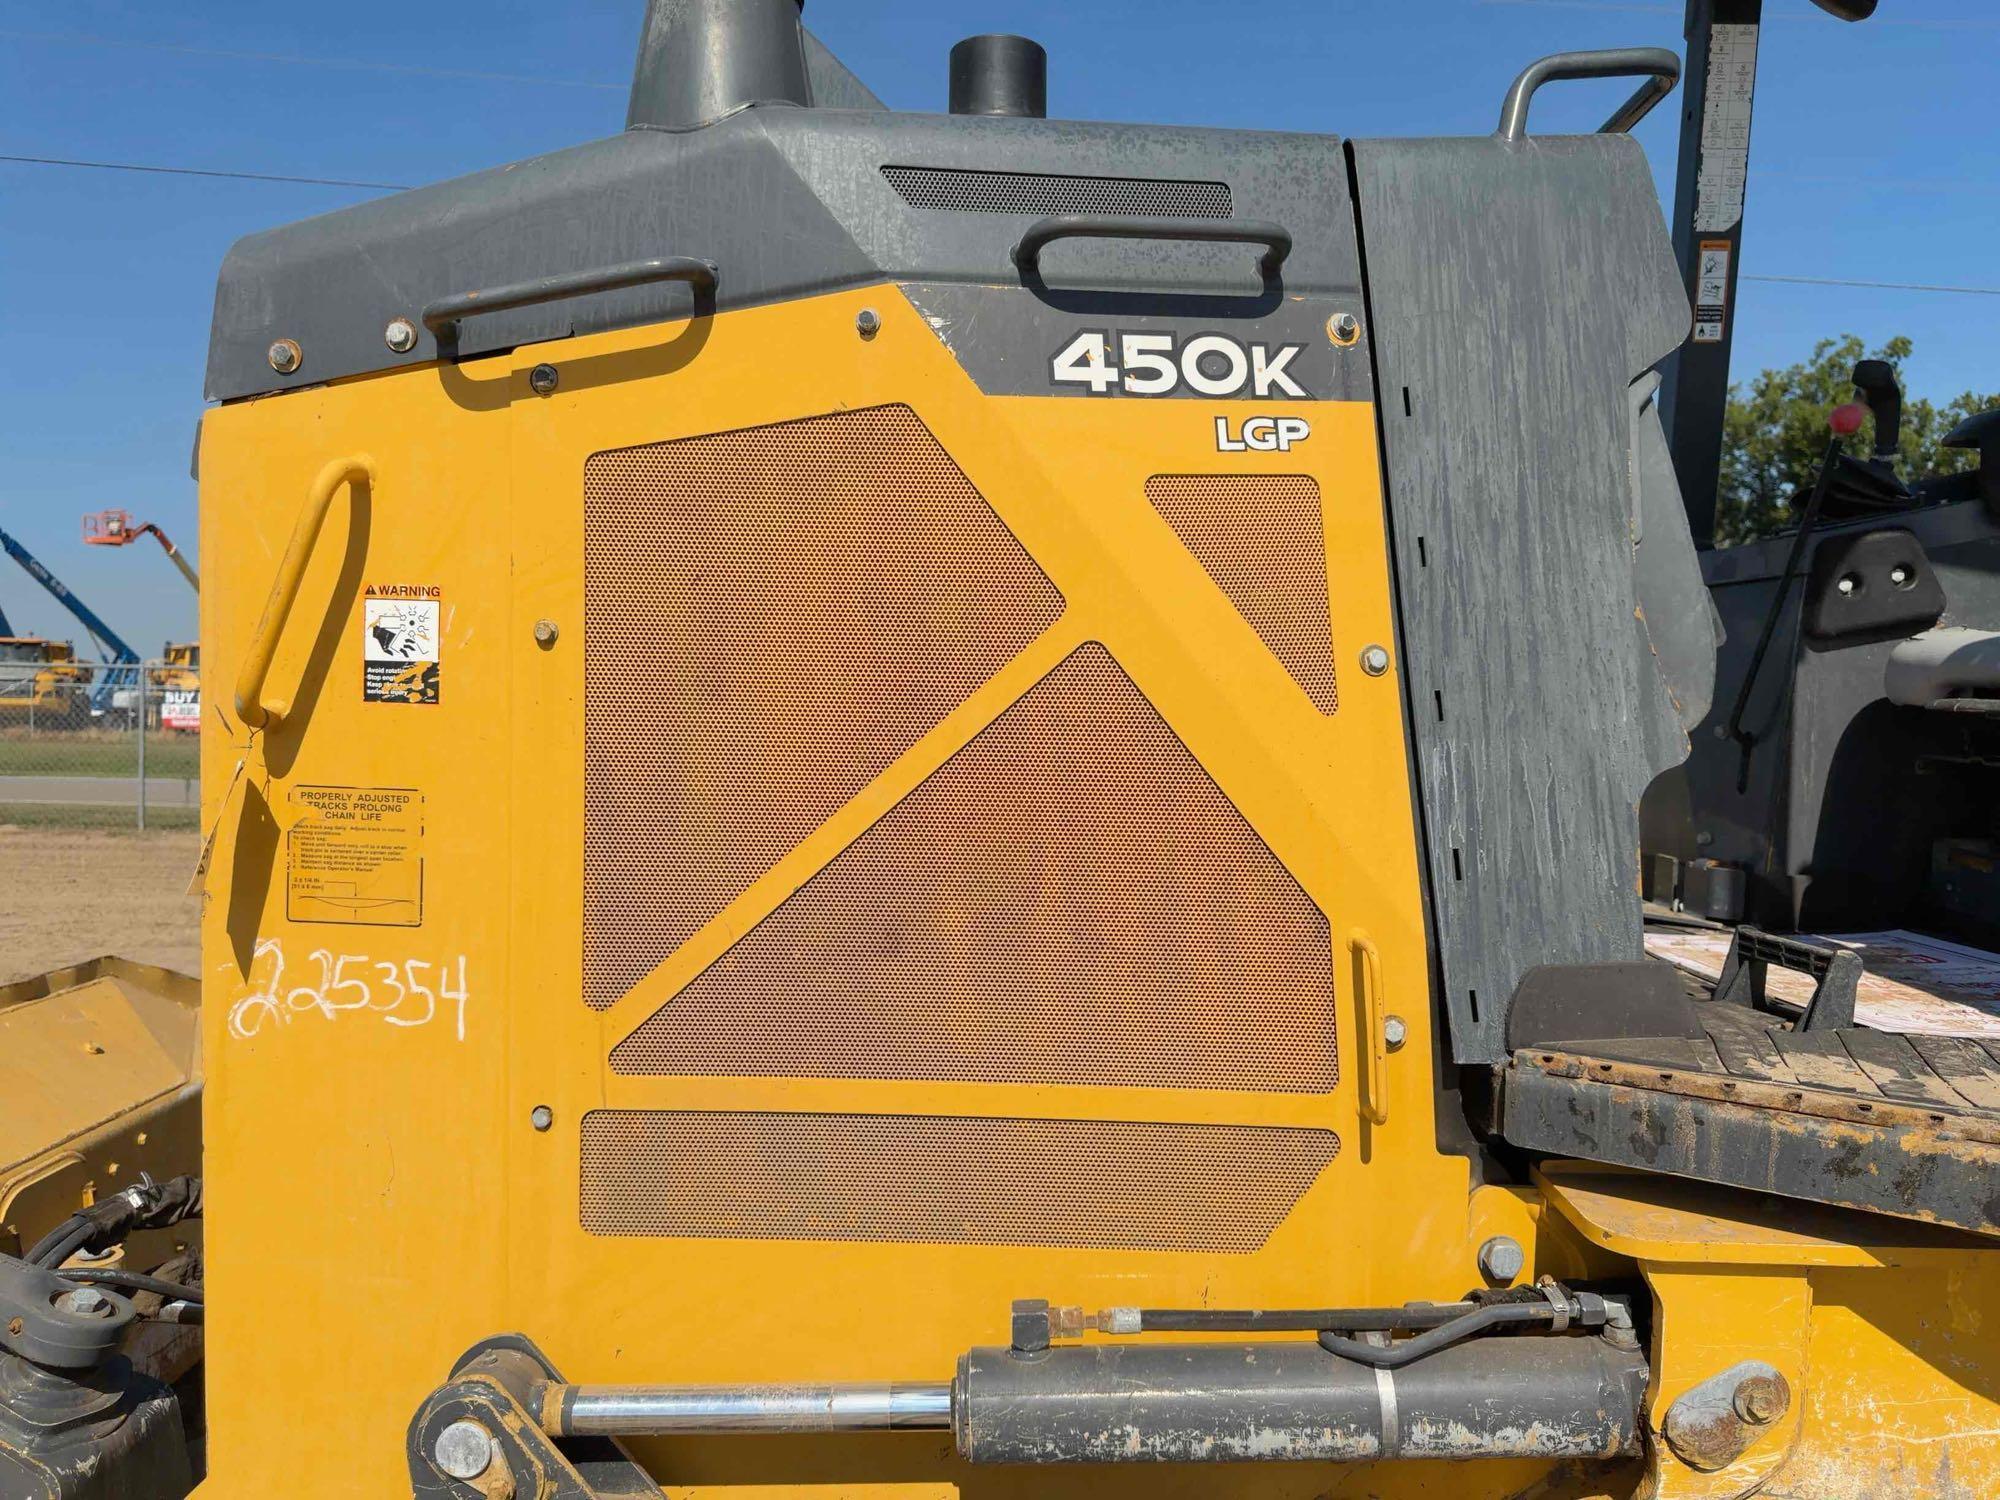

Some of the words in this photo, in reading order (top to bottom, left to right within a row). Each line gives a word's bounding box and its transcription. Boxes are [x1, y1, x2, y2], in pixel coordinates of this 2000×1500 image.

[1051, 331, 1309, 397] 450K
[1215, 417, 1310, 452] LGP
[379, 585, 440, 597] WARNING
[165, 691, 195, 703] BUY
[300, 791, 353, 800] PROPERLY
[357, 794, 410, 803] ADJUSTED
[353, 803, 402, 812] PROLONG
[325, 811, 355, 820] CHAIN
[361, 813, 382, 821] LIFE
[228, 938, 470, 1041] 225354
